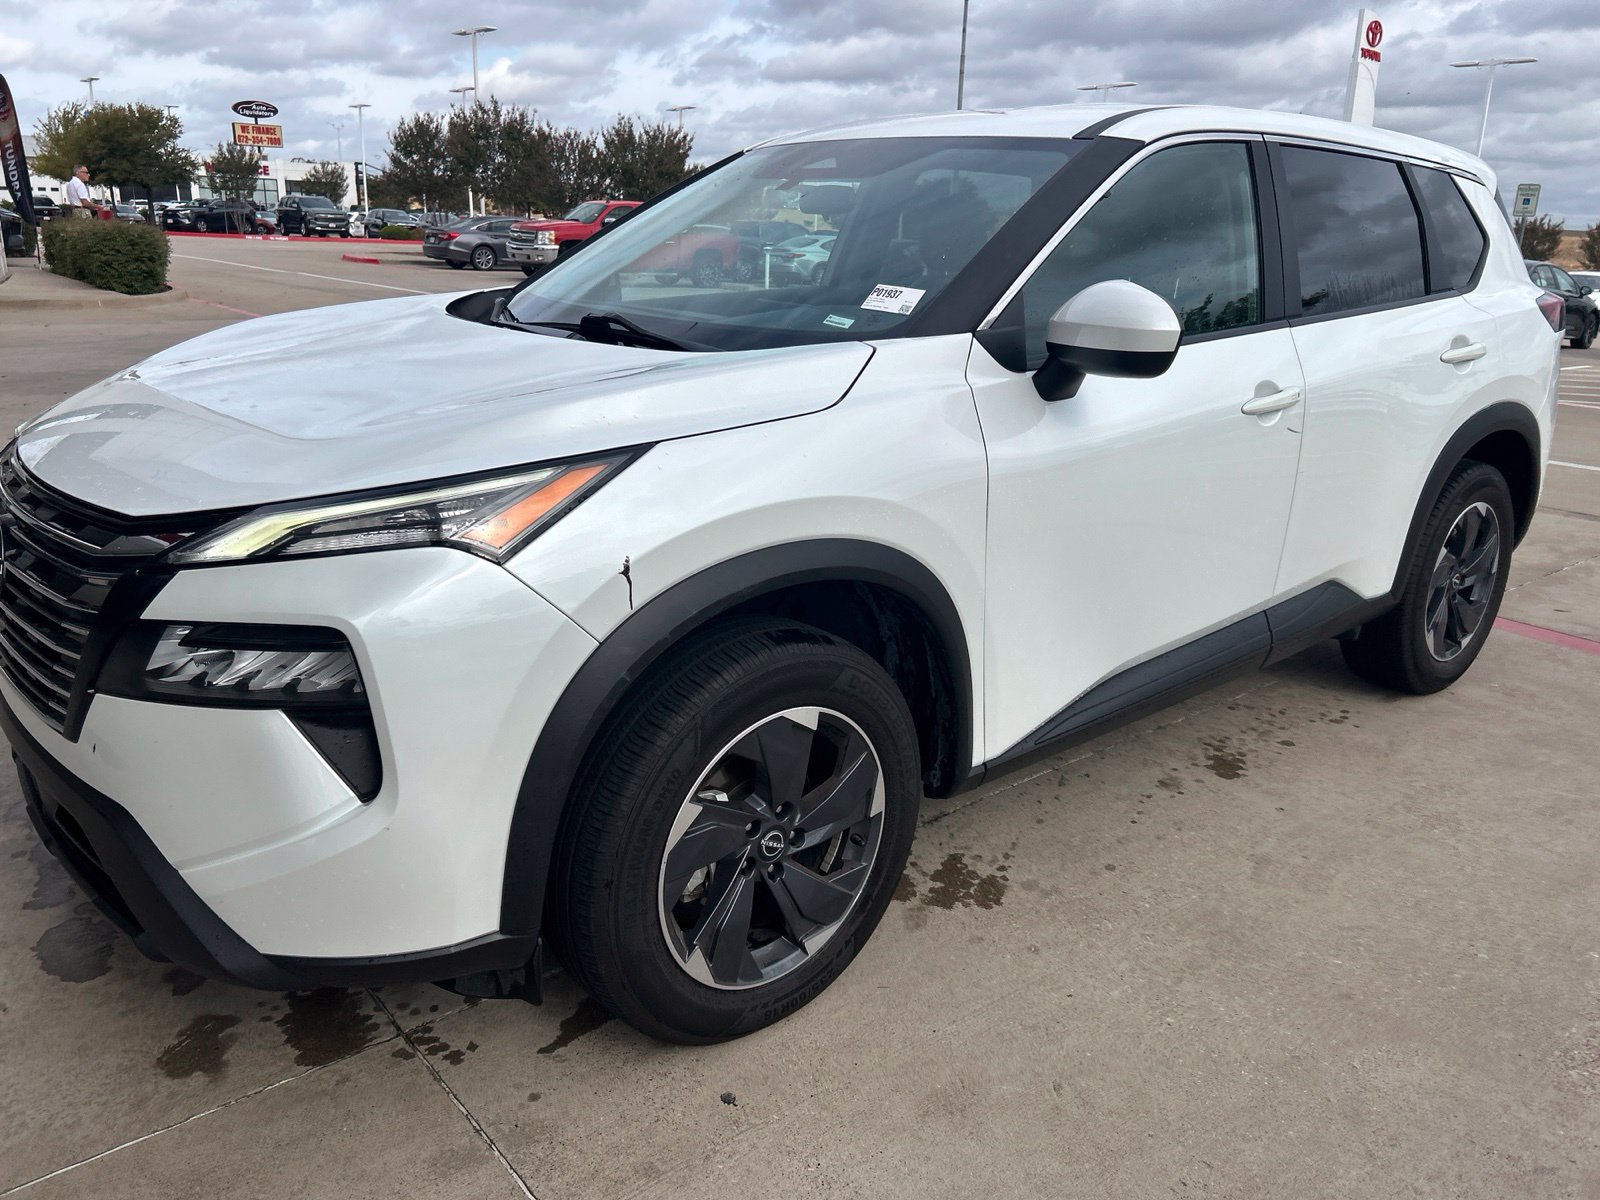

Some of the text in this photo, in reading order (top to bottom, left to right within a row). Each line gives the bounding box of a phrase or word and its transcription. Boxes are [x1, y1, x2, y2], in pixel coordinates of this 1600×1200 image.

[239, 108, 274, 117] Liquidators
[240, 125, 277, 136] WE FINANCE
[5, 140, 22, 200] TUNDRA
[871, 288, 903, 299] P01937
[760, 839, 785, 849] NISSAN
